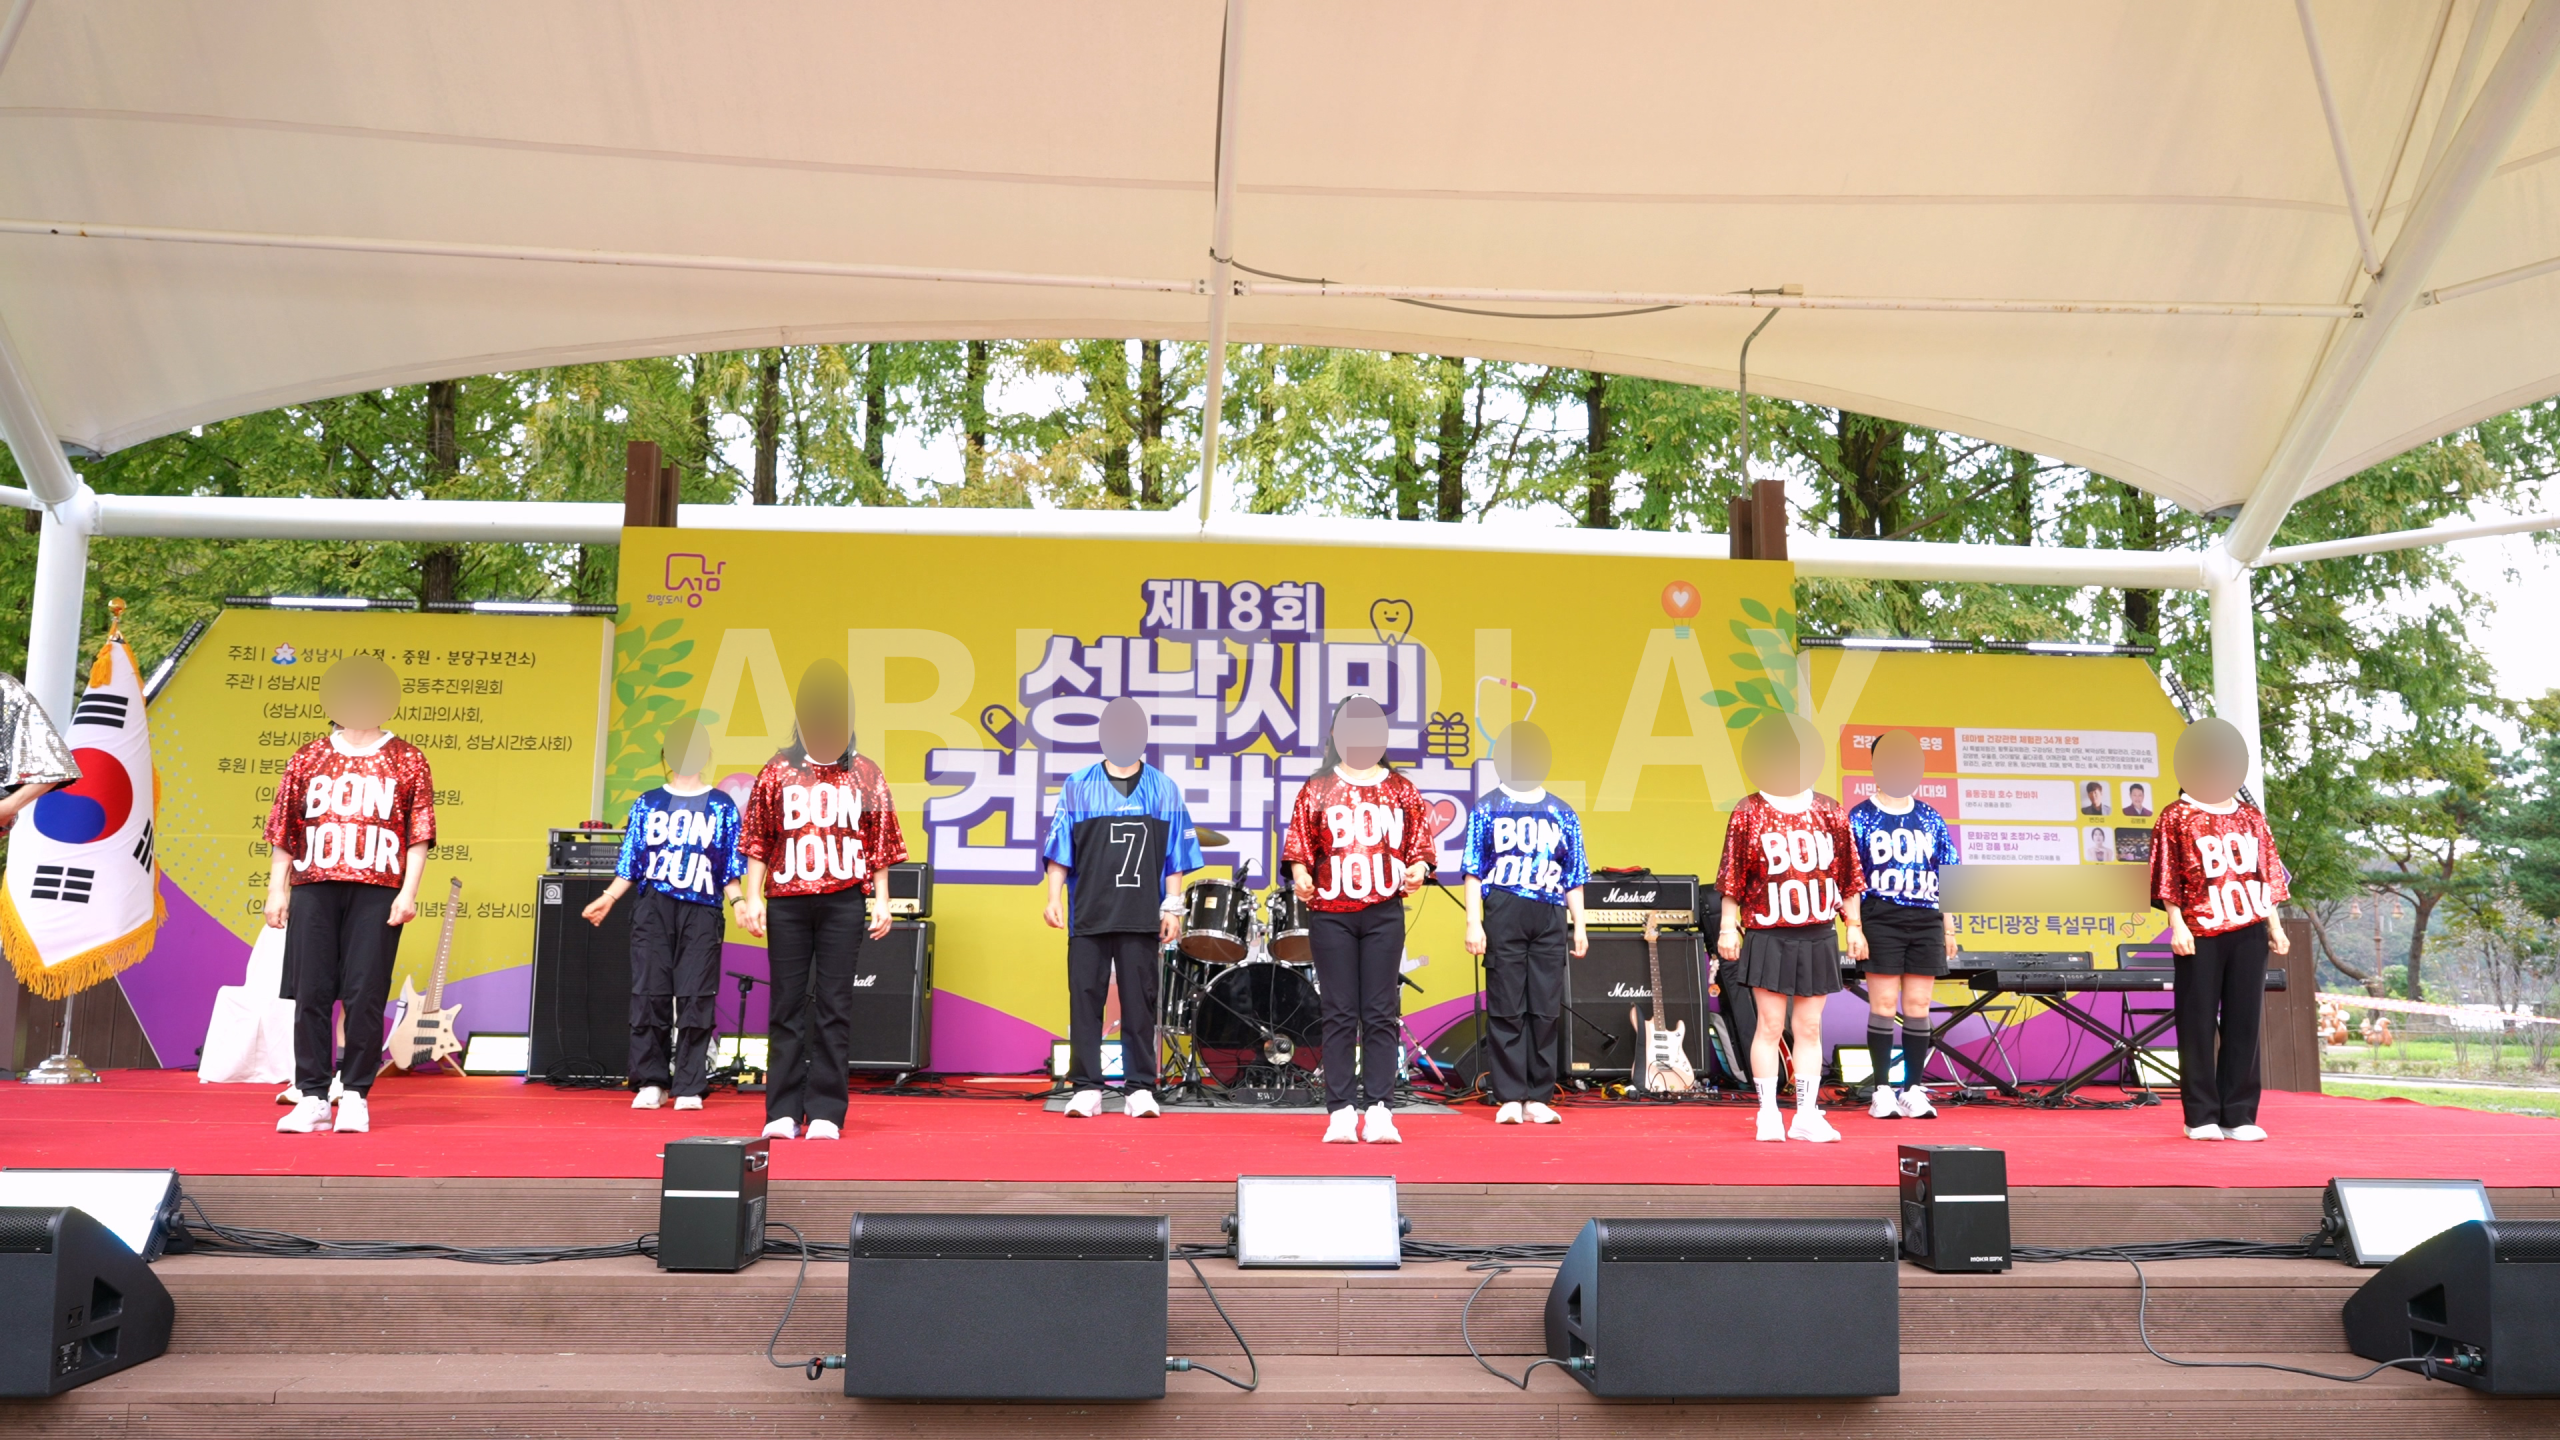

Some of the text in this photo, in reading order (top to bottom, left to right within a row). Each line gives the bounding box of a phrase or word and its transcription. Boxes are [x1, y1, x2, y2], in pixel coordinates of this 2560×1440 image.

[646, 593, 683, 607] 희망도시
[1144, 578, 1318, 634] 제18회
[228, 645, 256, 662] 주최
[300, 648, 343, 663] 성남시
[402, 649, 431, 666] 중원
[447, 650, 537, 668] 분당구보건소)
[225, 673, 254, 690] 주관
[402, 678, 504, 695] 공동추진위원회
[1026, 636, 1421, 752] 성남시민
[263, 702, 484, 723] (성남시의 시치과의사회,
[466, 734, 573, 752] 성남시간호사회)
[217, 757, 246, 774] 후원
[304, 770, 398, 821] BON
[1998, 790, 2013, 799] 호수
[782, 782, 862, 831] BON
[646, 809, 717, 849] BON
[1327, 802, 1404, 850] BON
[1493, 816, 1561, 854] BON
[1967, 831, 1998, 841] 문화공연
[2010, 832, 2041, 841] 초청가수
[292, 822, 400, 875] JOUR
[1110, 821, 1148, 888] 7
[1761, 829, 1835, 875] BON
[1870, 828, 1935, 865] BON
[1968, 842, 1984, 851] 시민
[1602, 888, 1657, 903] Marshall
[1968, 915, 2040, 935] 잔디광장
[2045, 915, 2115, 936] 특설무대
[1607, 982, 1653, 998] Marsha
